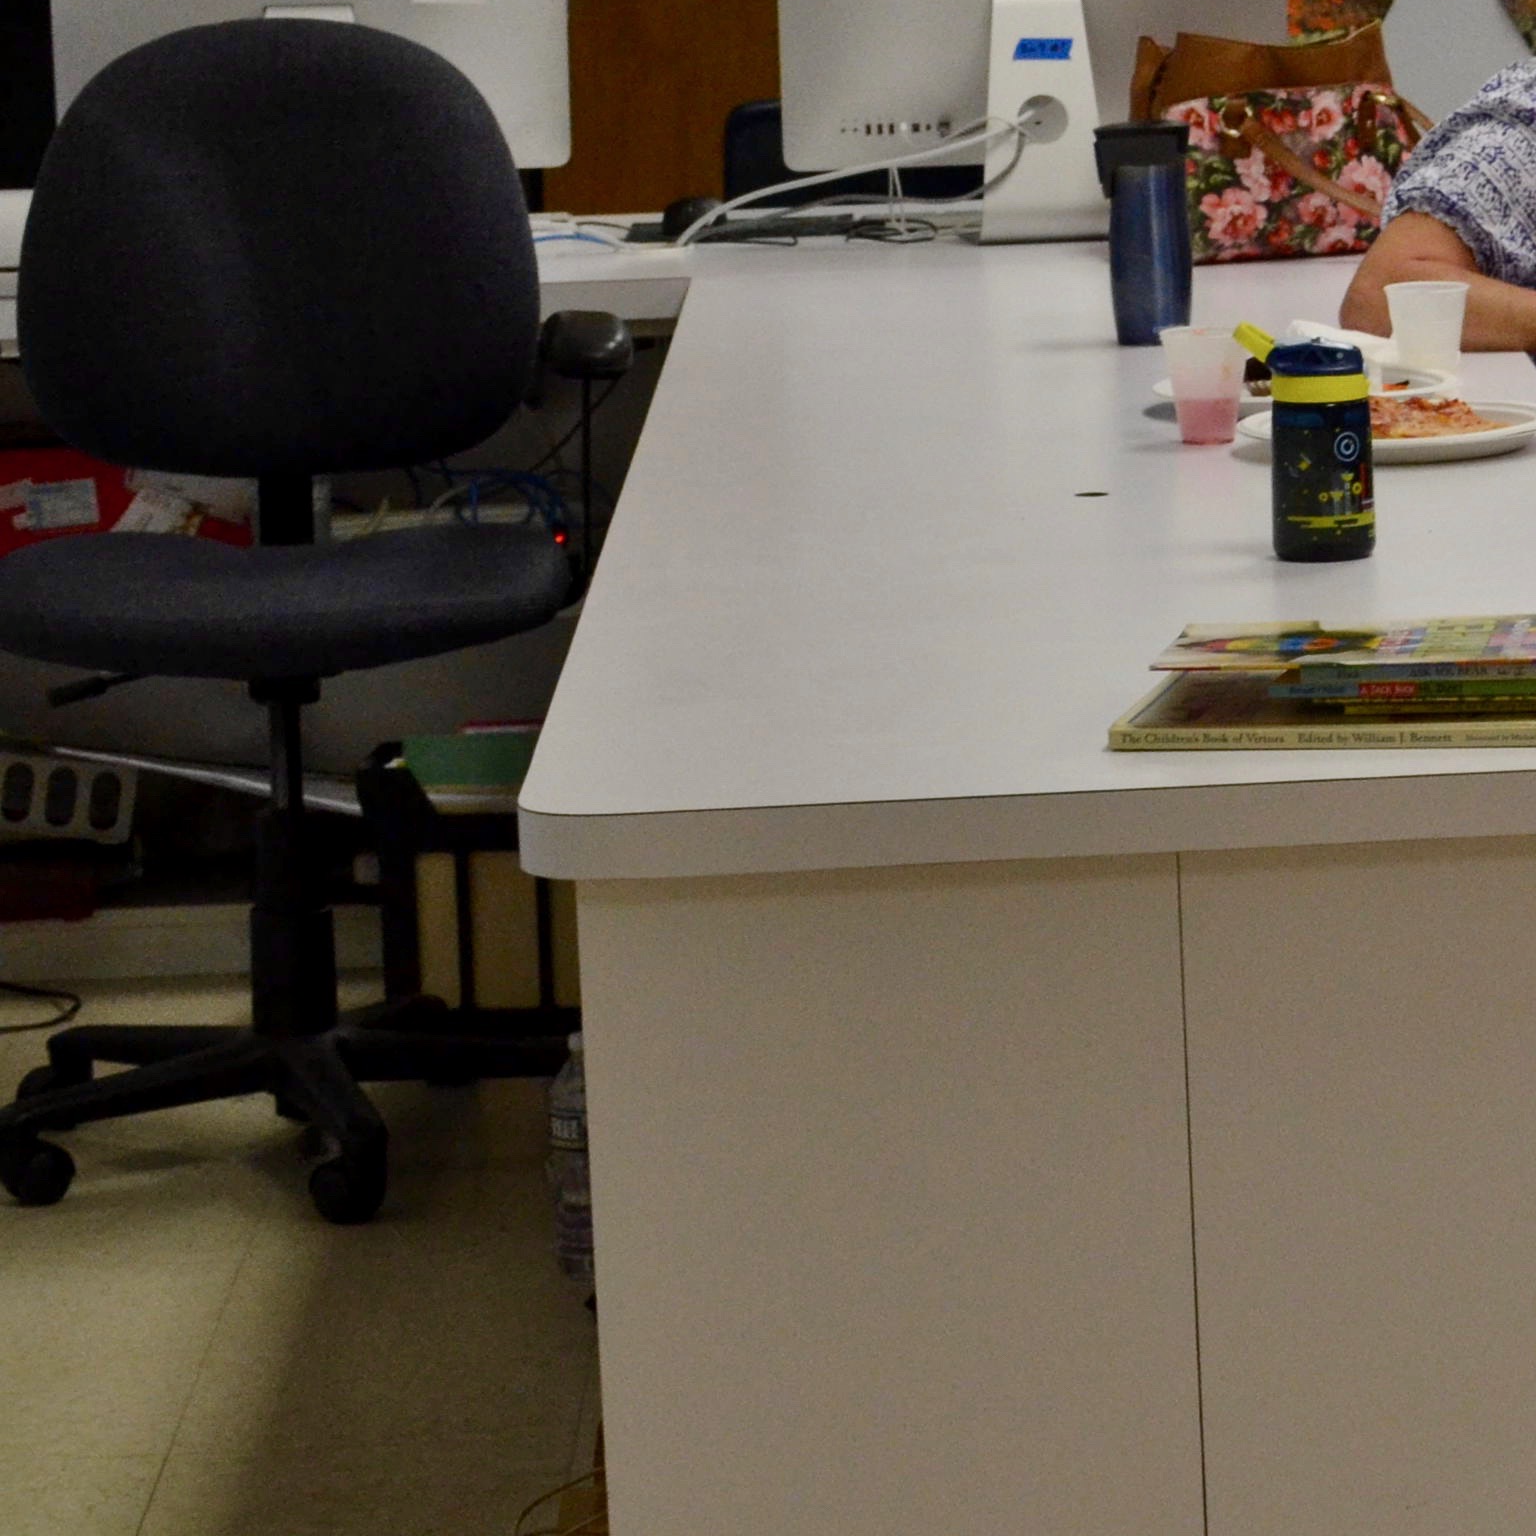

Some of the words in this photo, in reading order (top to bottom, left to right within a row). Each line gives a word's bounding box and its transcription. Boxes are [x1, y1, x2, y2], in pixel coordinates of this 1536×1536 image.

[1120, 733, 1141, 744] The
[1144, 732, 1199, 744] Children's
[1202, 732, 1228, 743] Book
[1232, 732, 1244, 743] of
[1297, 731, 1333, 743] Edited
[1337, 732, 1348, 745] by
[1352, 731, 1397, 743] William
[1409, 731, 1452, 742] Bennett
